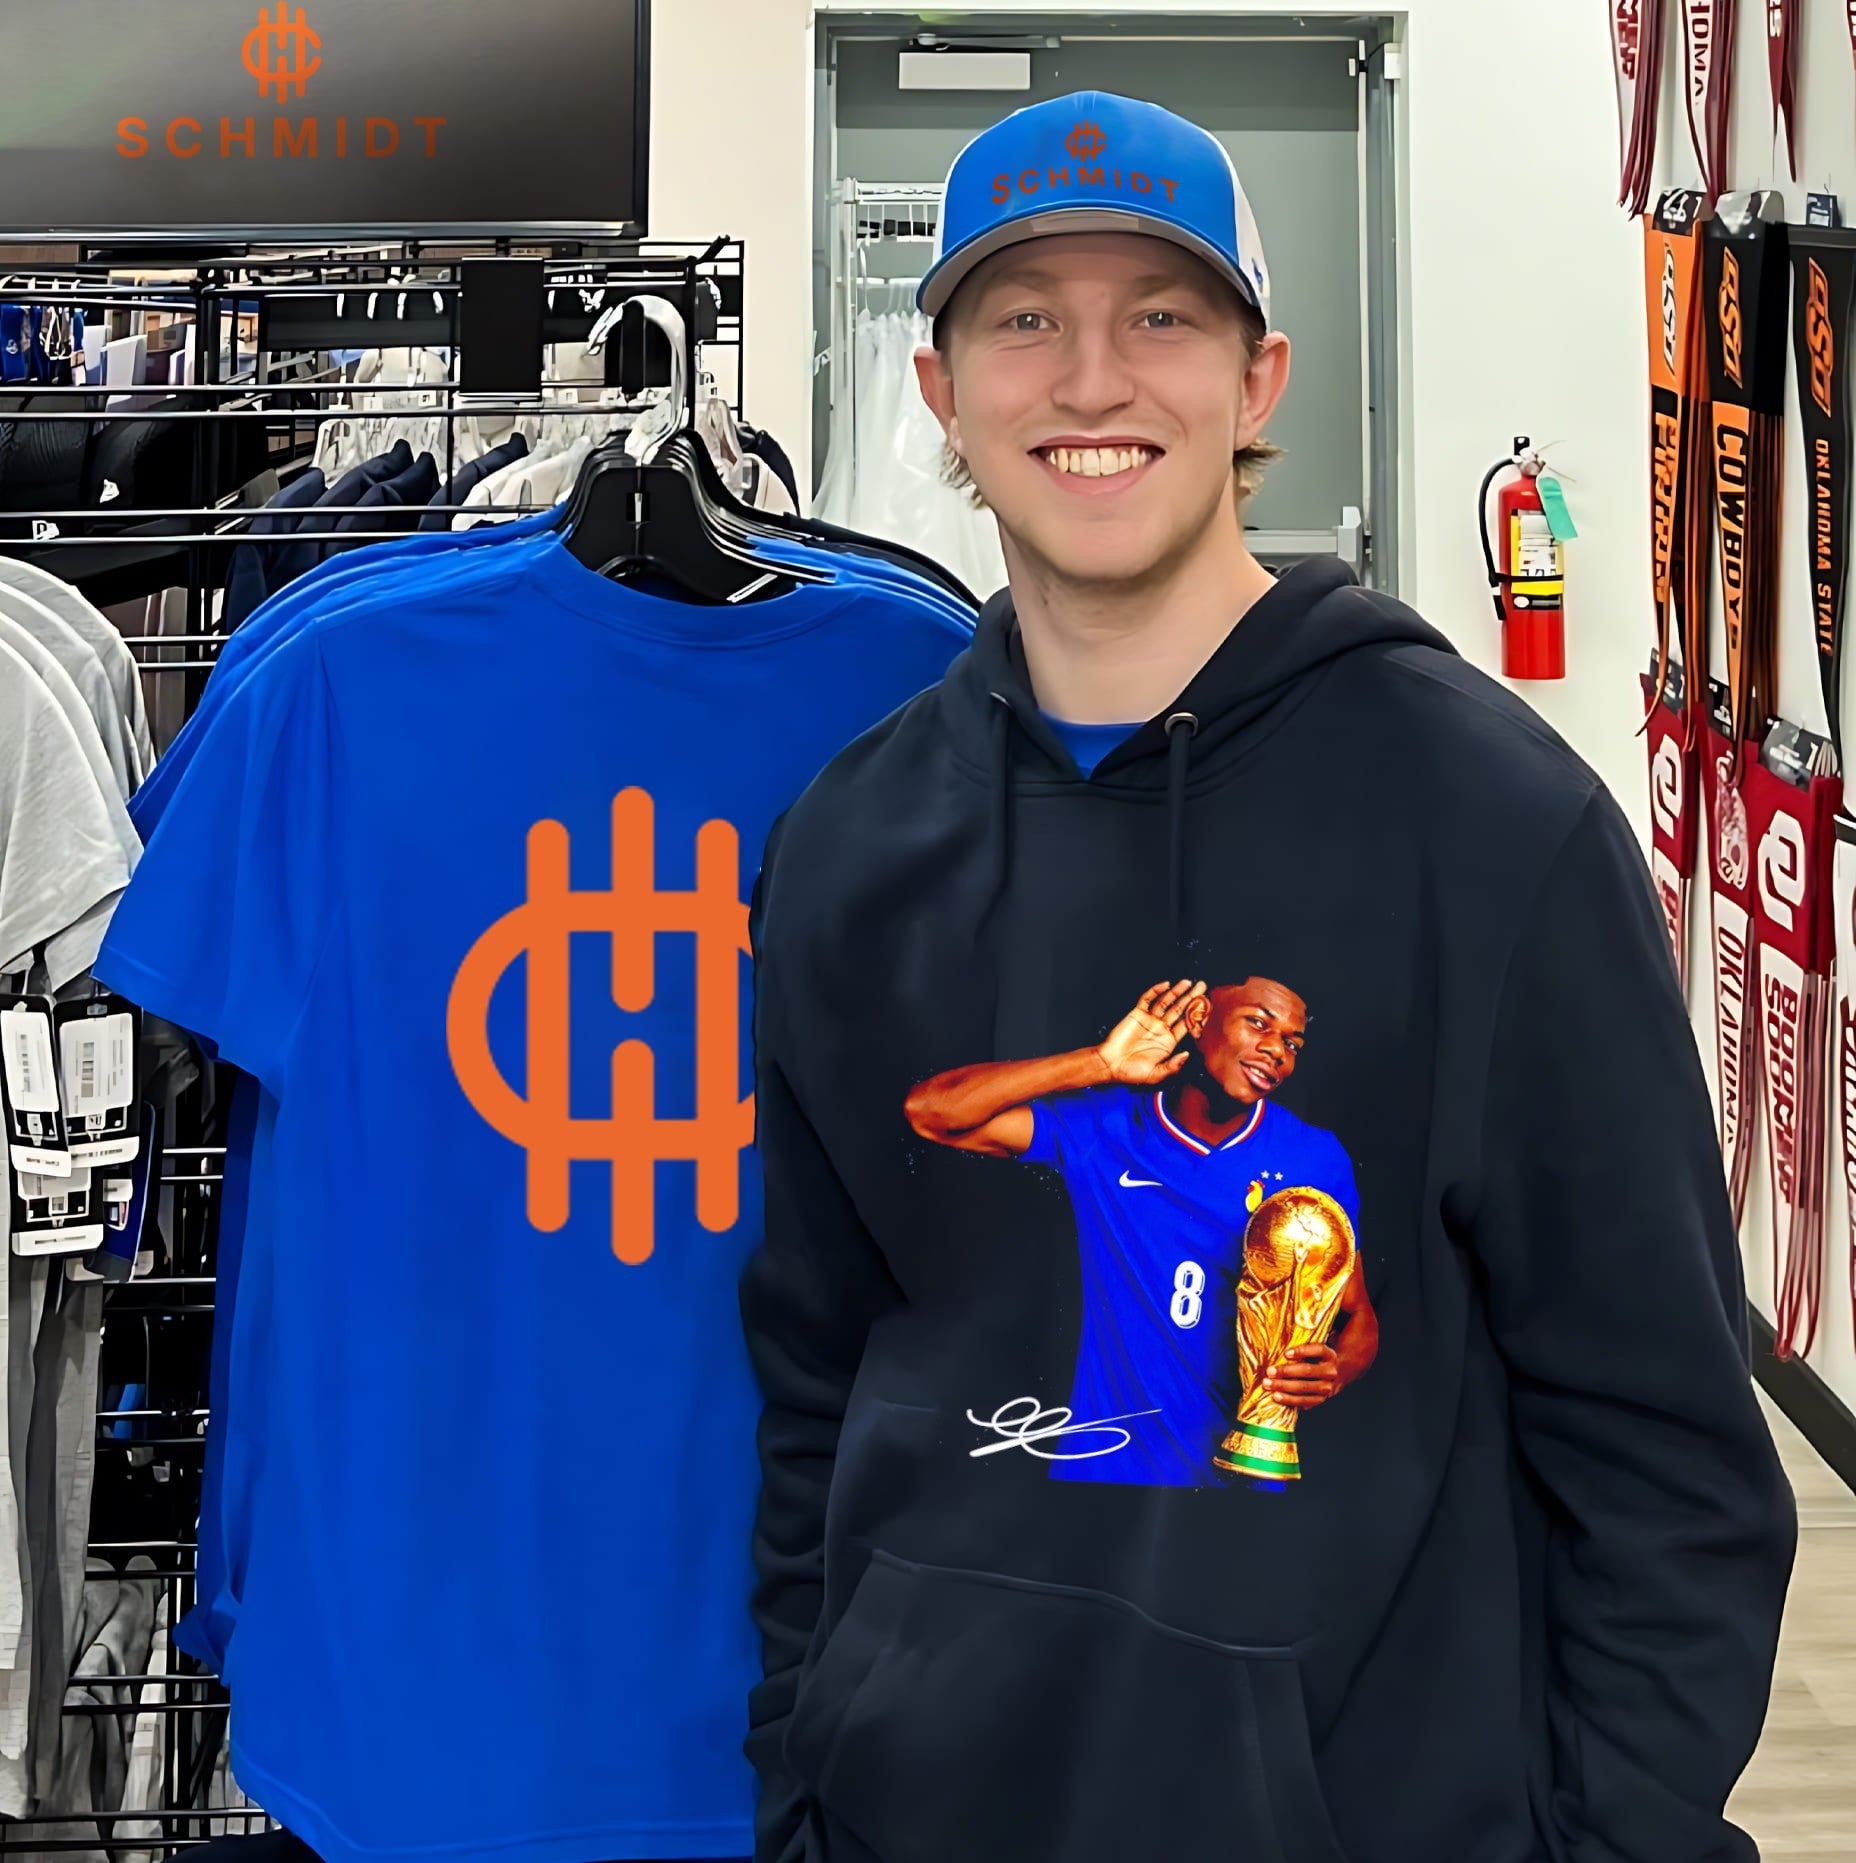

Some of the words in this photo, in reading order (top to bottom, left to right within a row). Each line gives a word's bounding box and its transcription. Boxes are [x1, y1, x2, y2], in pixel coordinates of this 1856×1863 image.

[116, 116, 447, 159] SCHMIDT
[991, 166, 1179, 205] SCHMIDT
[1815, 438, 1832, 571] OKLAHOMA
[1170, 1260, 1205, 1329] 8
